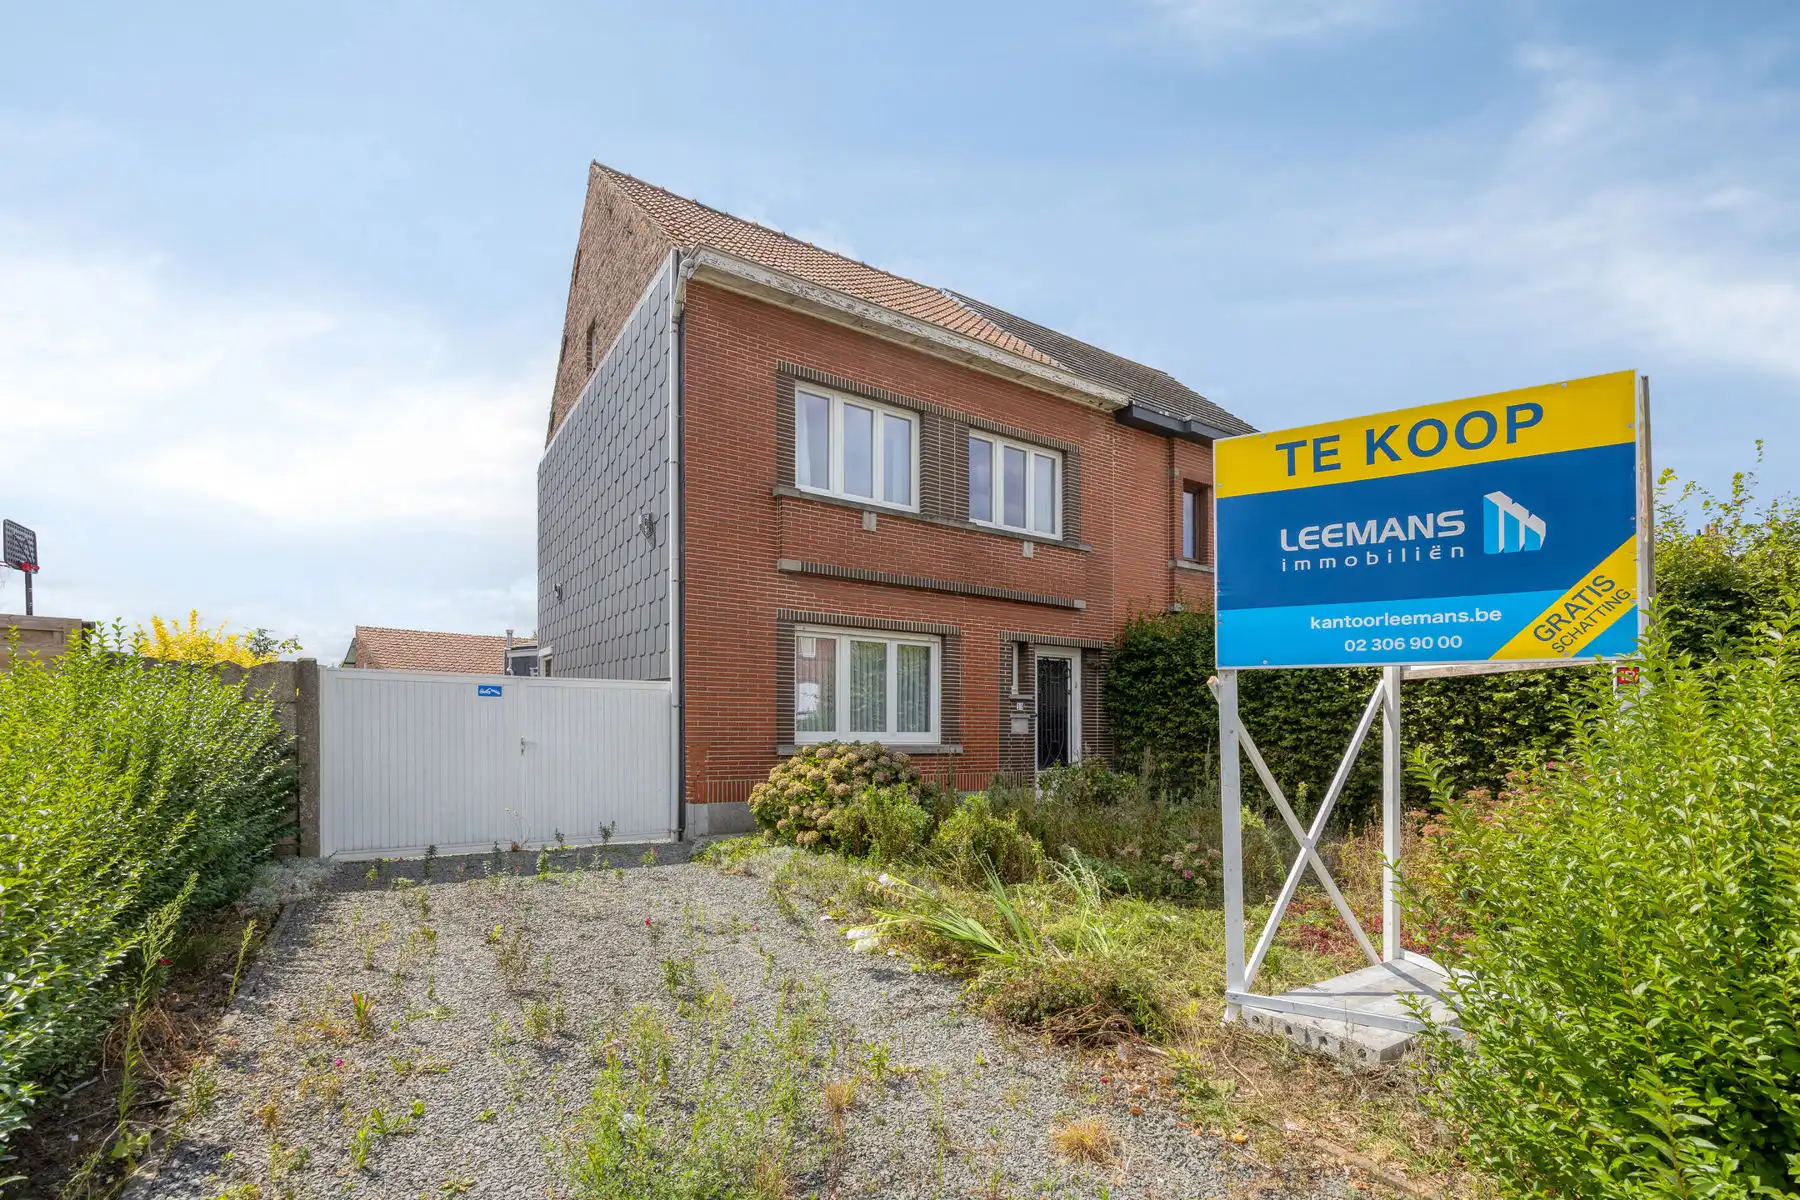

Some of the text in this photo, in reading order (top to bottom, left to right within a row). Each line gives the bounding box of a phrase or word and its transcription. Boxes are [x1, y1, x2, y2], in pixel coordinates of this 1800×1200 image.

[1275, 402, 1544, 477] TE KOOP
[1280, 509, 1466, 552] LEEMANS
[1281, 546, 1465, 572] immobiliën
[1310, 607, 1502, 629] kantoorleemans.be
[1533, 574, 1616, 643] GRATIS
[1551, 587, 1632, 654] SCHATTING
[1344, 635, 1463, 652] 02 306 90 00
